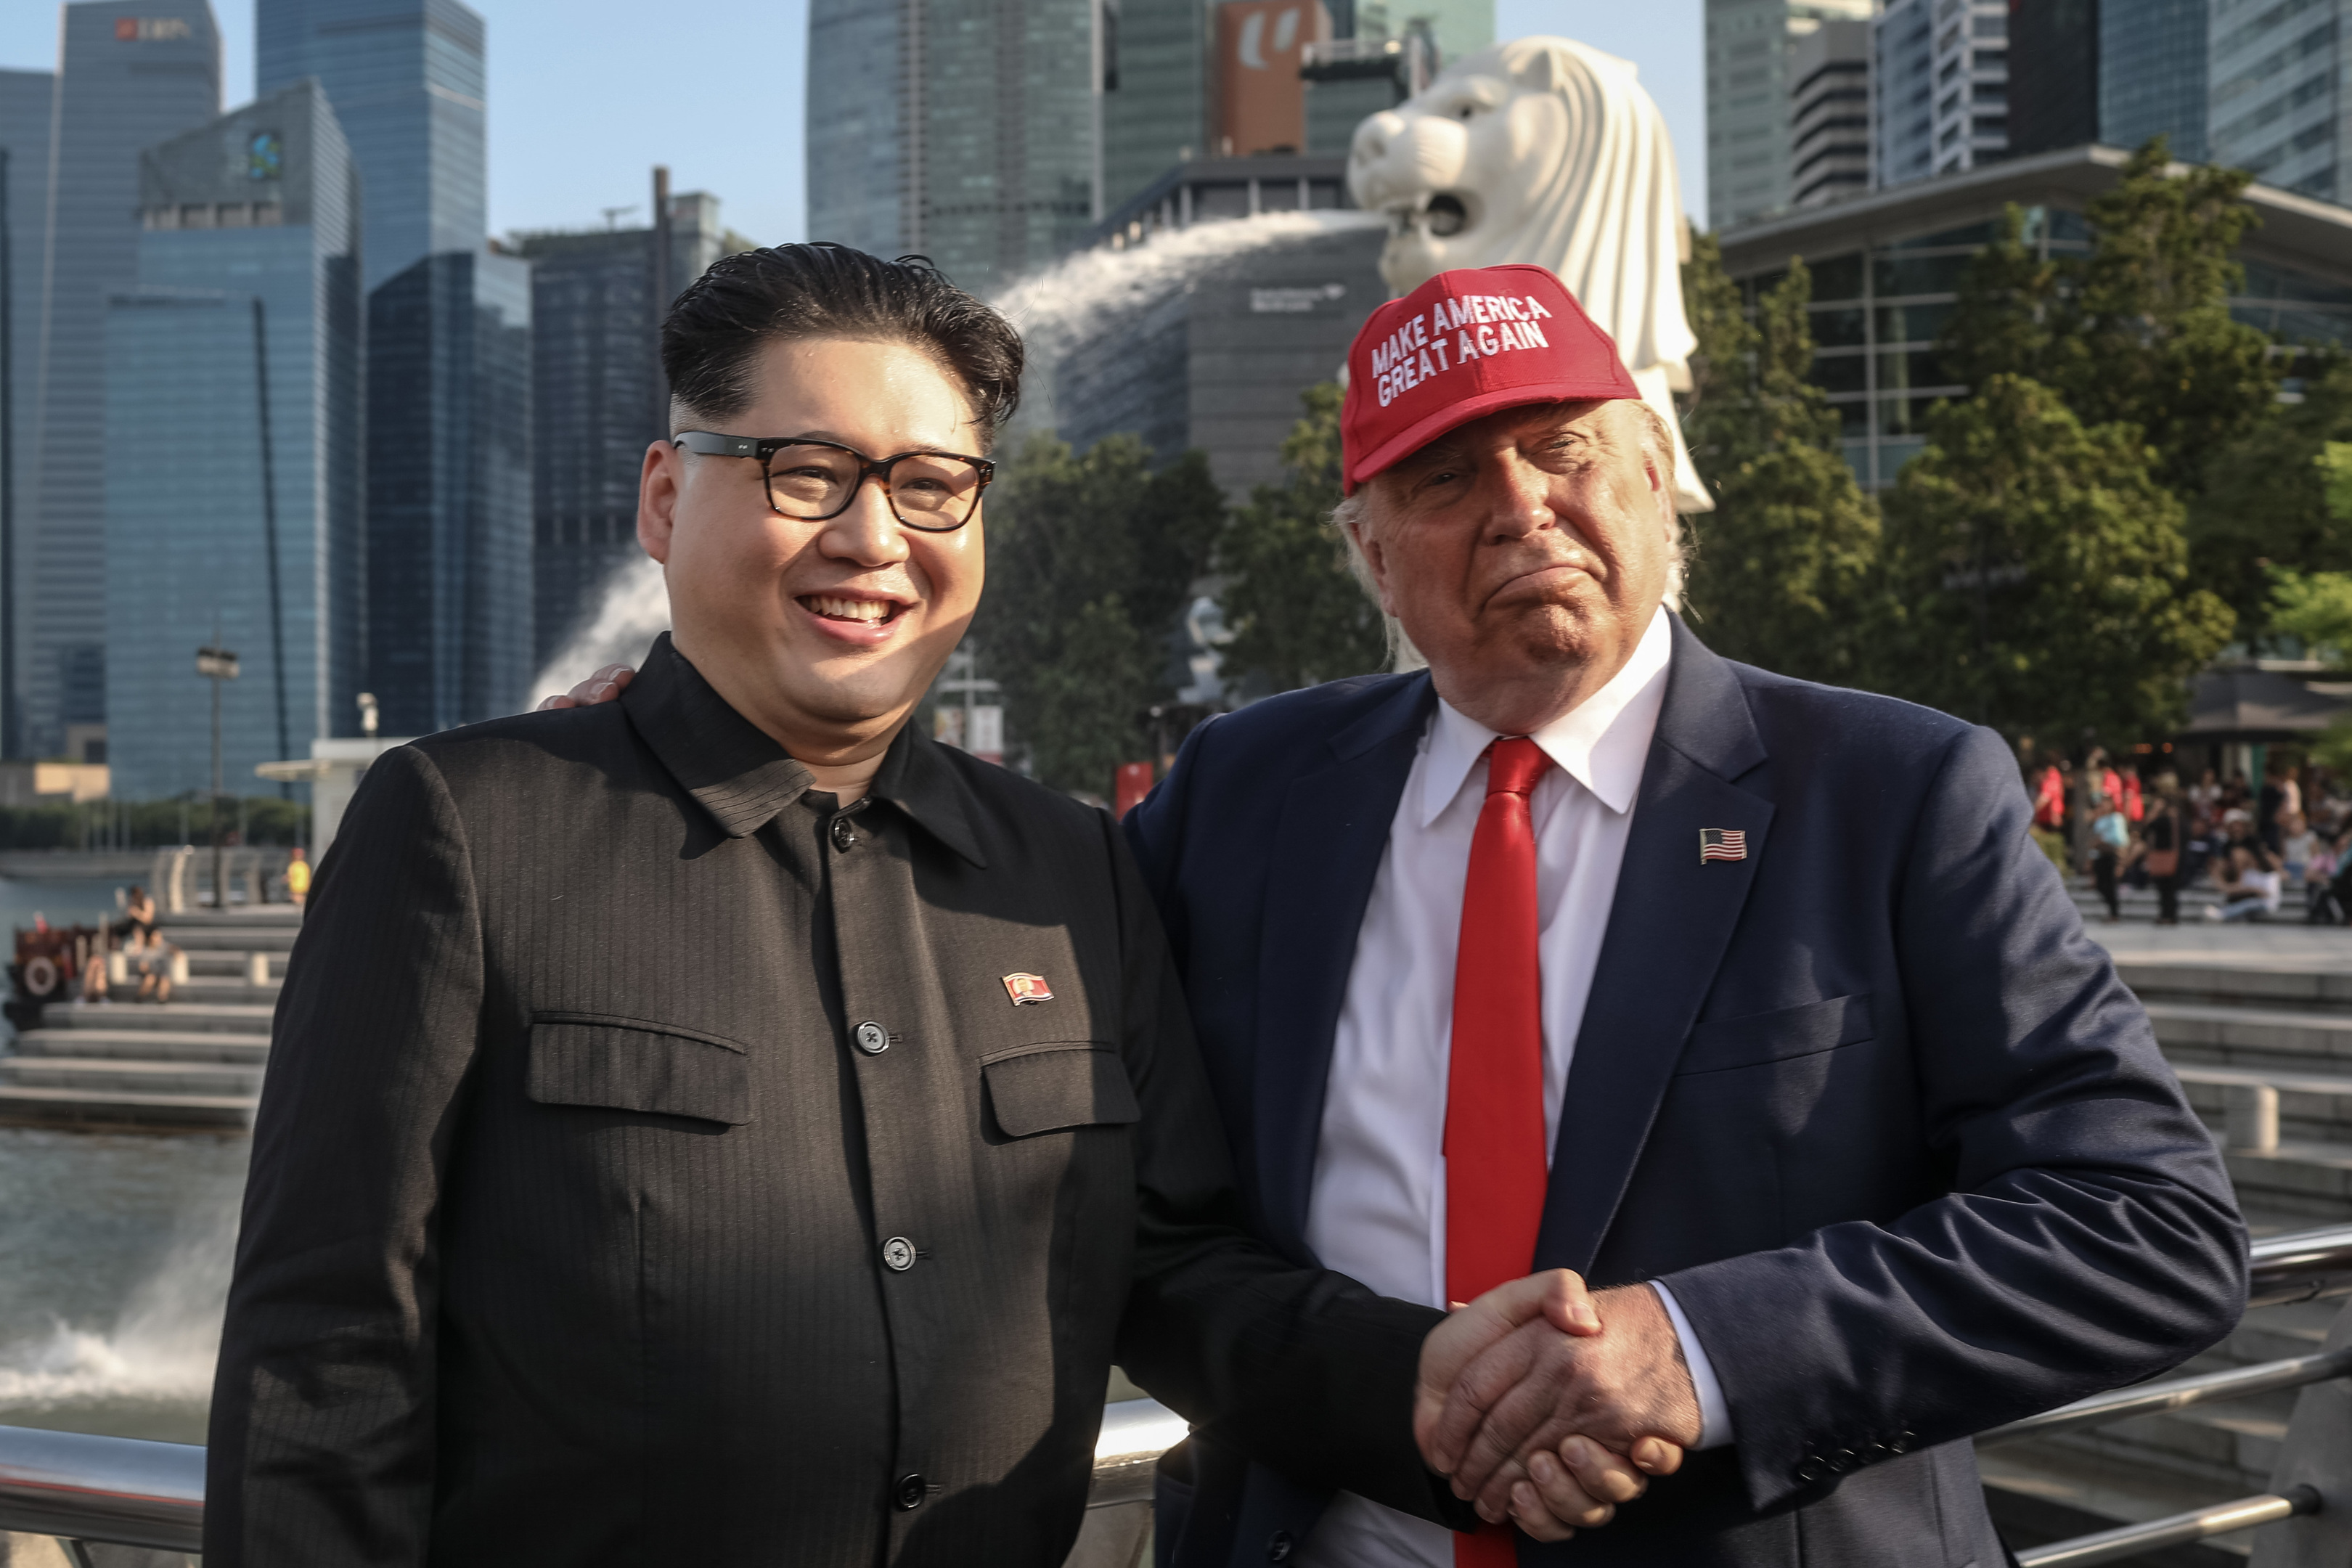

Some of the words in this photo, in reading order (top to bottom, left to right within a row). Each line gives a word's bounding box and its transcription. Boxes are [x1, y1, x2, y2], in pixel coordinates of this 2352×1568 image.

[1371, 314, 1429, 378] MAKE
[1433, 295, 1552, 336] AMERICA
[1378, 338, 1450, 407] GREAT
[1457, 320, 1549, 364] AGAIN
